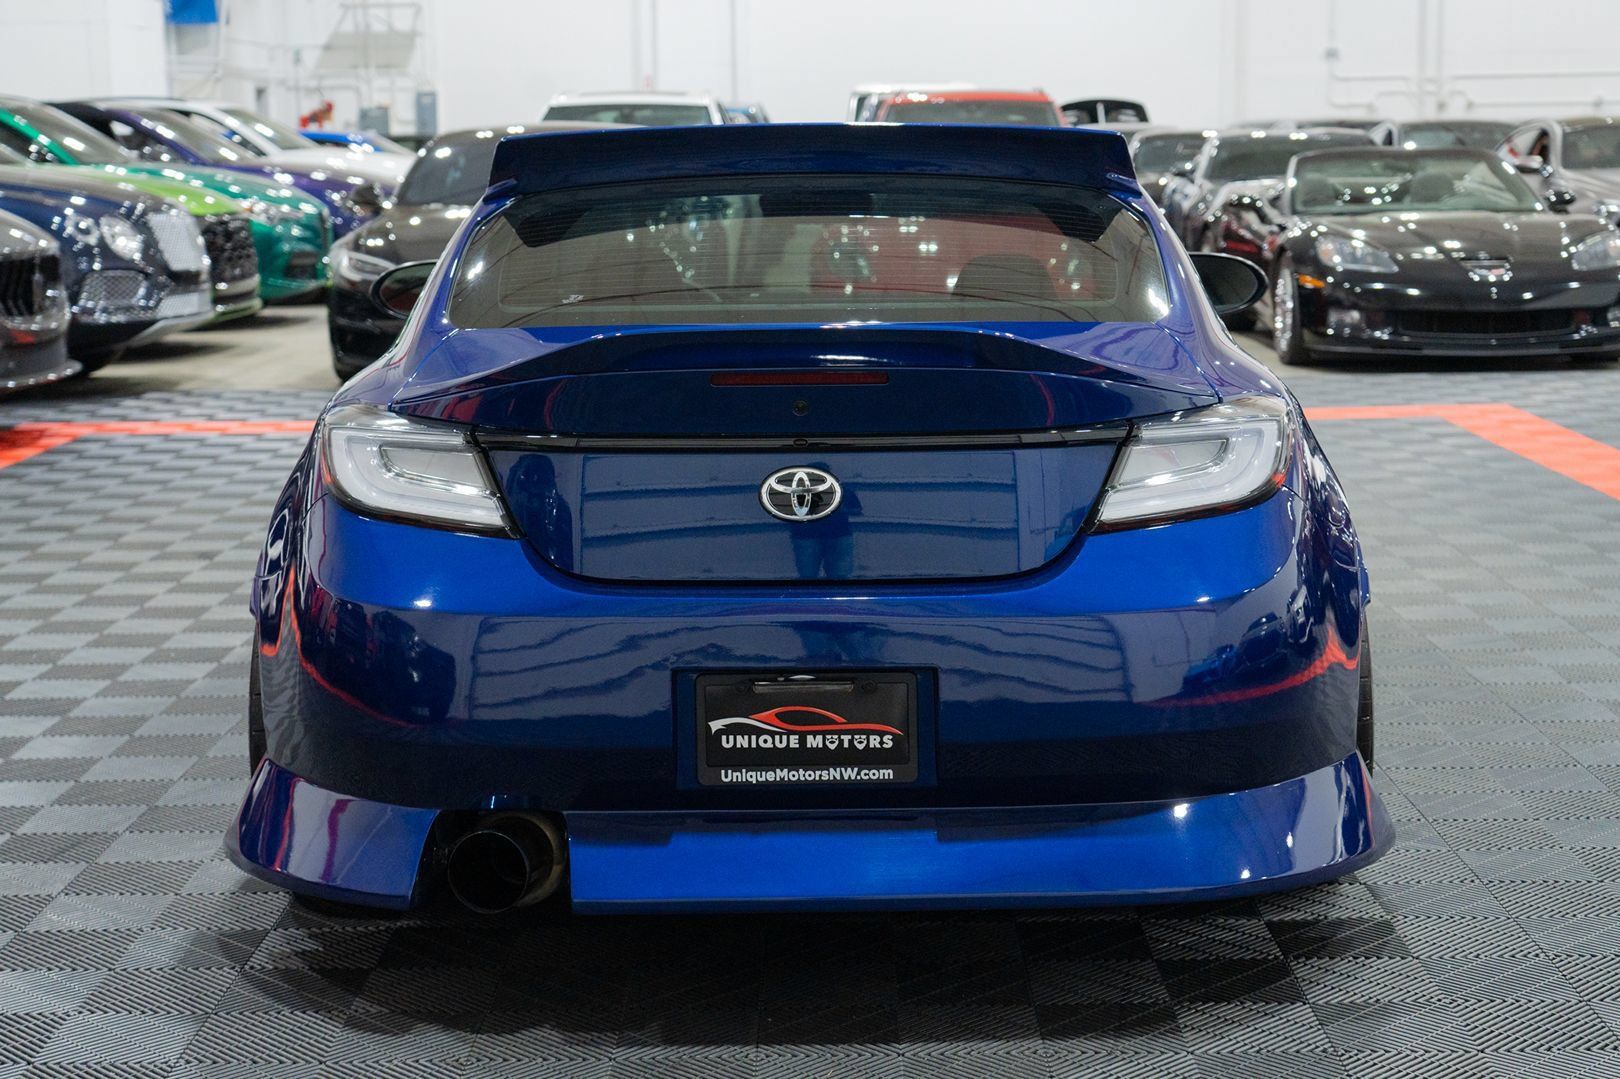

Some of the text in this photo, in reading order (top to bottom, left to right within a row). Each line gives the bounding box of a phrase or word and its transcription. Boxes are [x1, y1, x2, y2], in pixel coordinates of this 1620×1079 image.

[721, 735, 894, 750] UNIQUE MOTORS
[720, 767, 894, 784] UniqueMotorsNW.com
